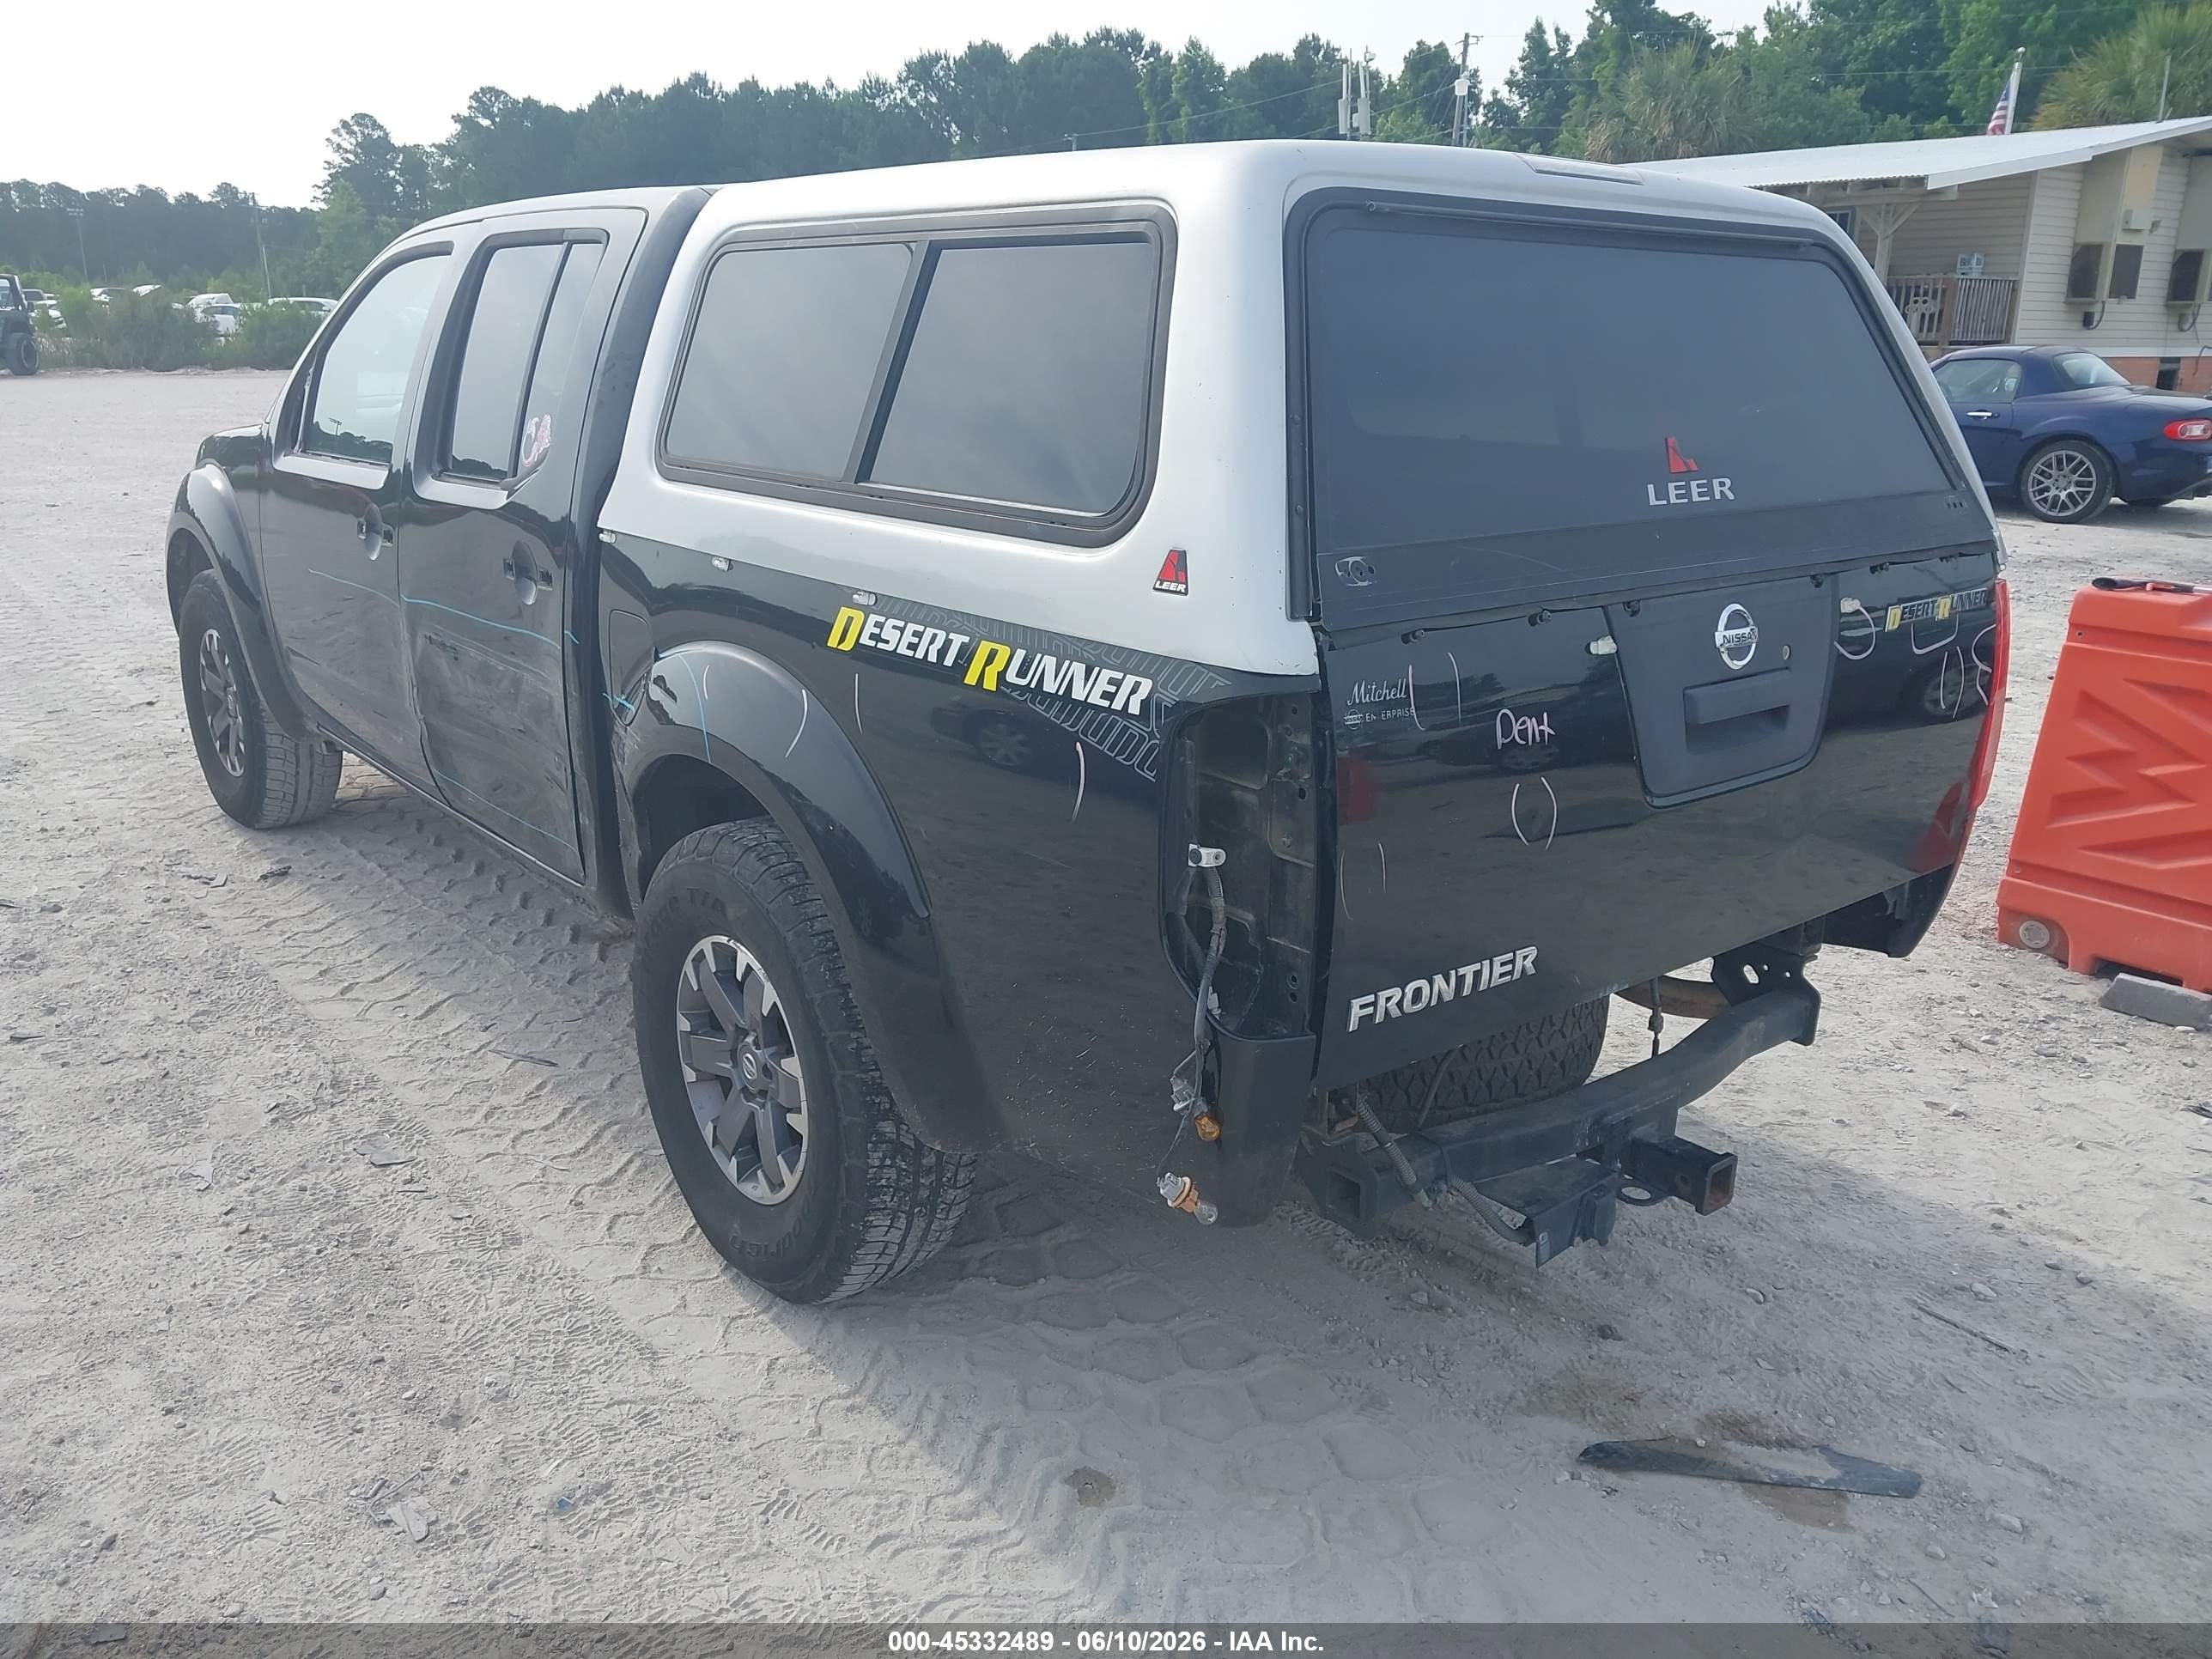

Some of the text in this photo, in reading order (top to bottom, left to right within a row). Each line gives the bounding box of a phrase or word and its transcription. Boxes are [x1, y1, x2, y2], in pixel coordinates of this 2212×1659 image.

[1647, 477, 1735, 506] LEER
[1154, 580, 1187, 593] LEER
[1723, 628, 1758, 644] NISSAN
[827, 606, 1154, 716] DESERT RUNNER
[1346, 678, 1408, 706] Mitchell
[1347, 945, 1540, 1034] FRONTIER
